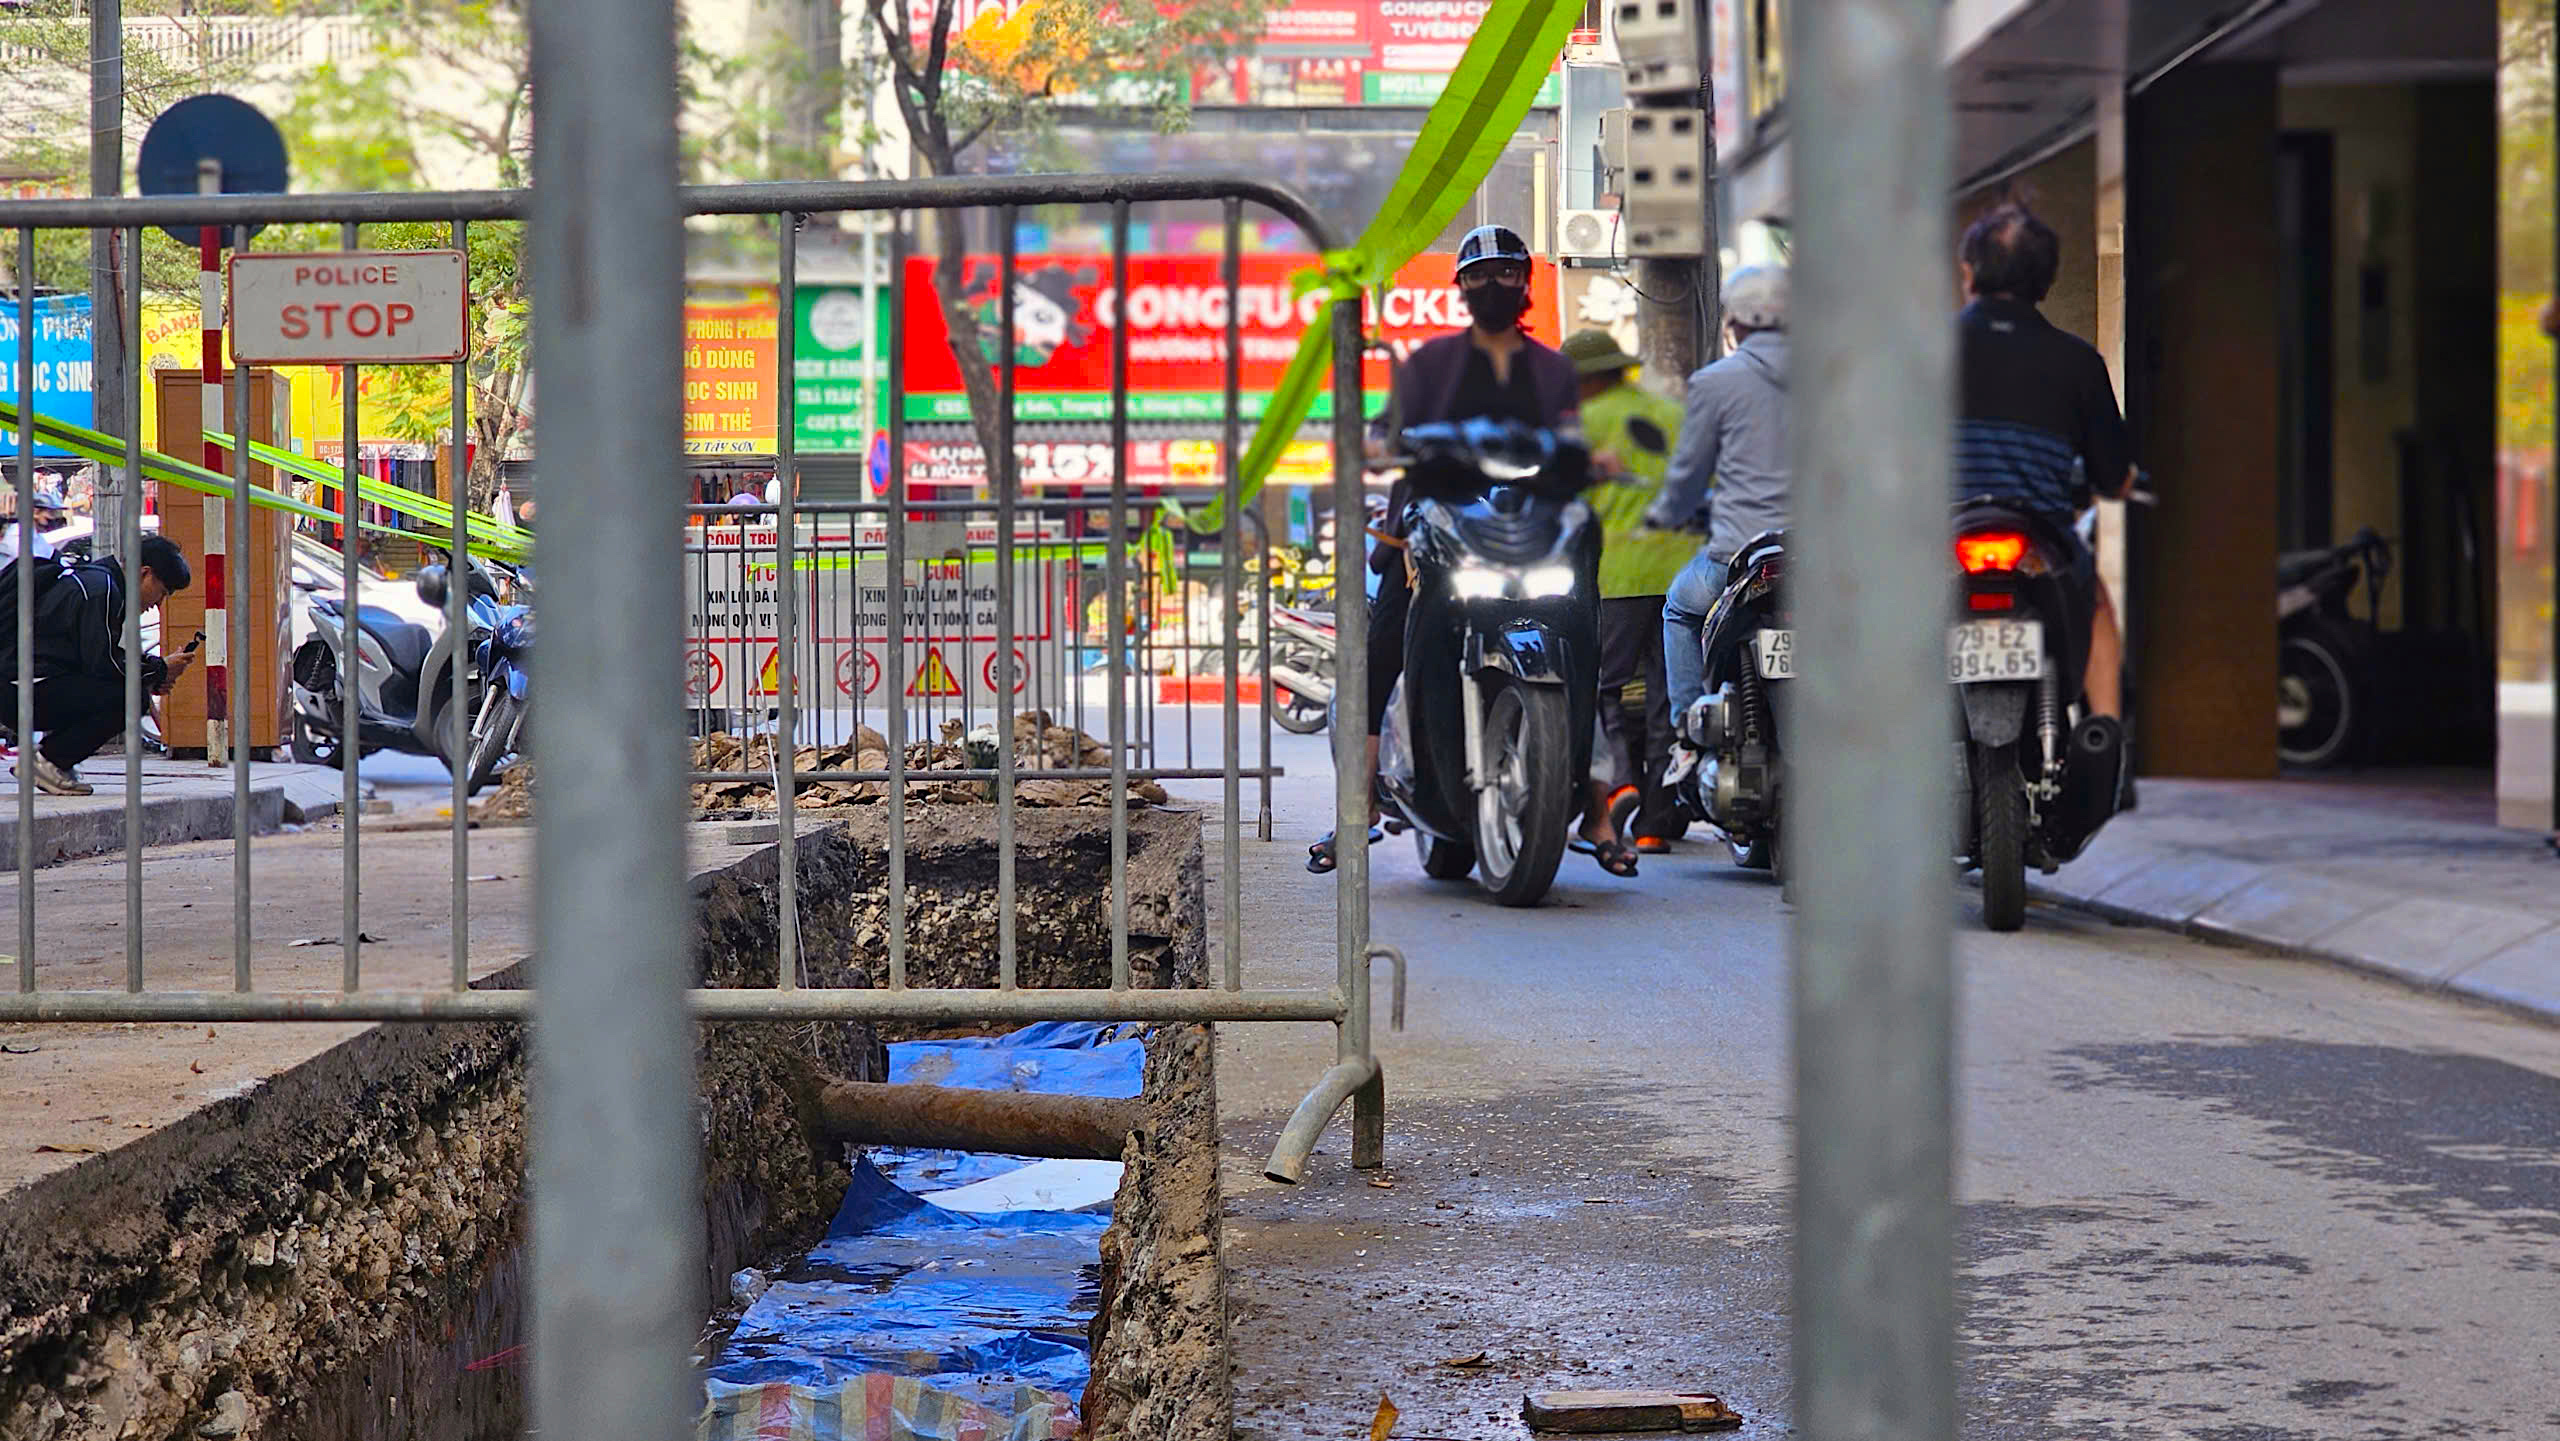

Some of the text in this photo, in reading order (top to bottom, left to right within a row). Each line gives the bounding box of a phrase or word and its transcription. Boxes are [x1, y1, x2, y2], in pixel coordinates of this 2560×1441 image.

[295, 265, 399, 286] POLICE
[280, 302, 415, 340] STOP
[706, 346, 756, 369] DÙNG
[685, 381, 758, 404] ỌC SINH
[684, 413, 715, 432] SIM
[865, 590, 886, 603] XIN
[759, 613, 771, 629] VỊ
